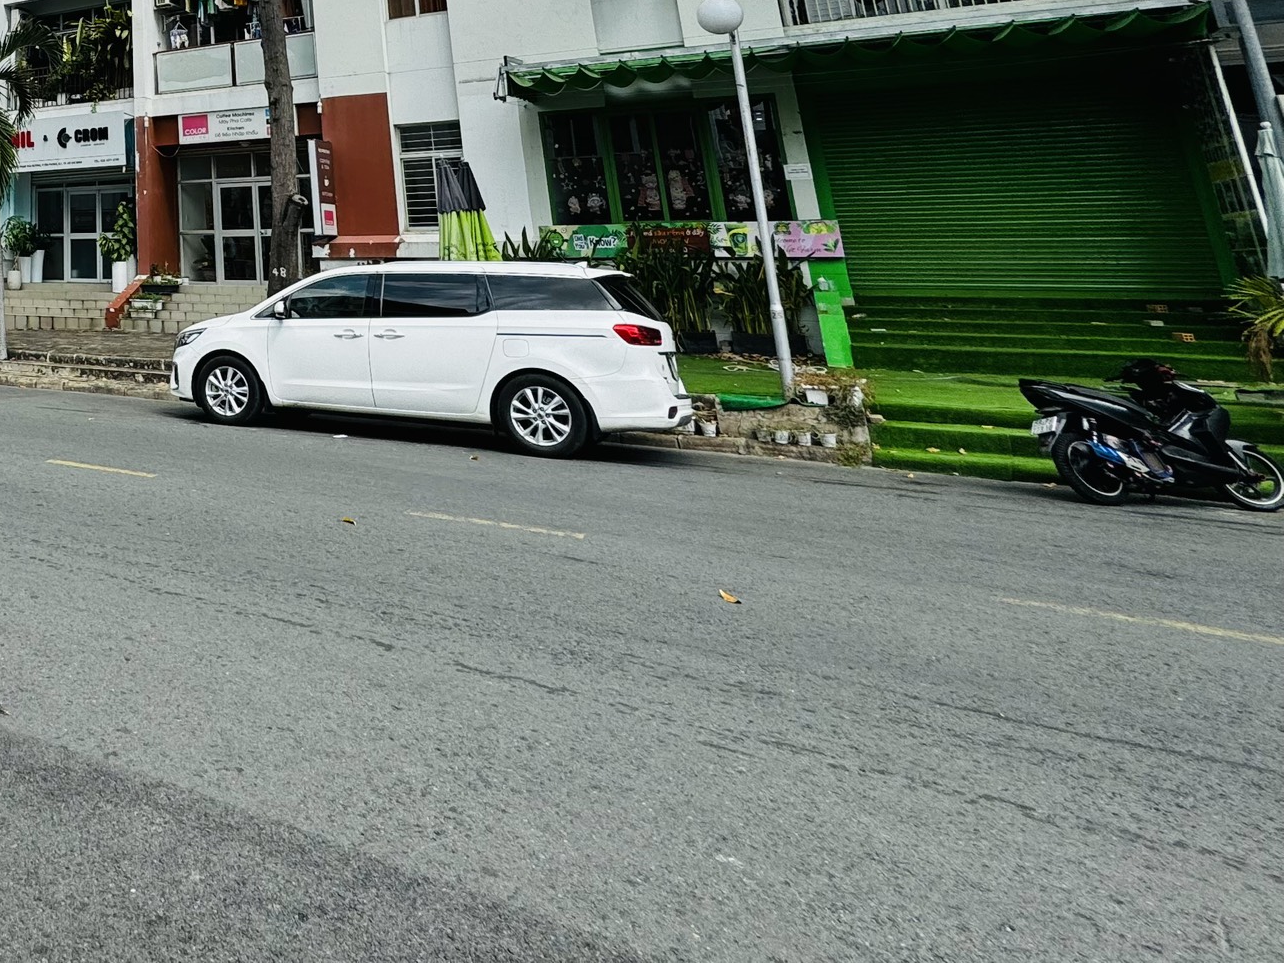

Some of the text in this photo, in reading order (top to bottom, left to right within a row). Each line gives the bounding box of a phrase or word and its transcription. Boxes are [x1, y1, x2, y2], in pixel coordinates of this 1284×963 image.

[74, 127, 108, 143] CROM
[184, 127, 207, 135] COLOR
[272, 267, 286, 277] 48
